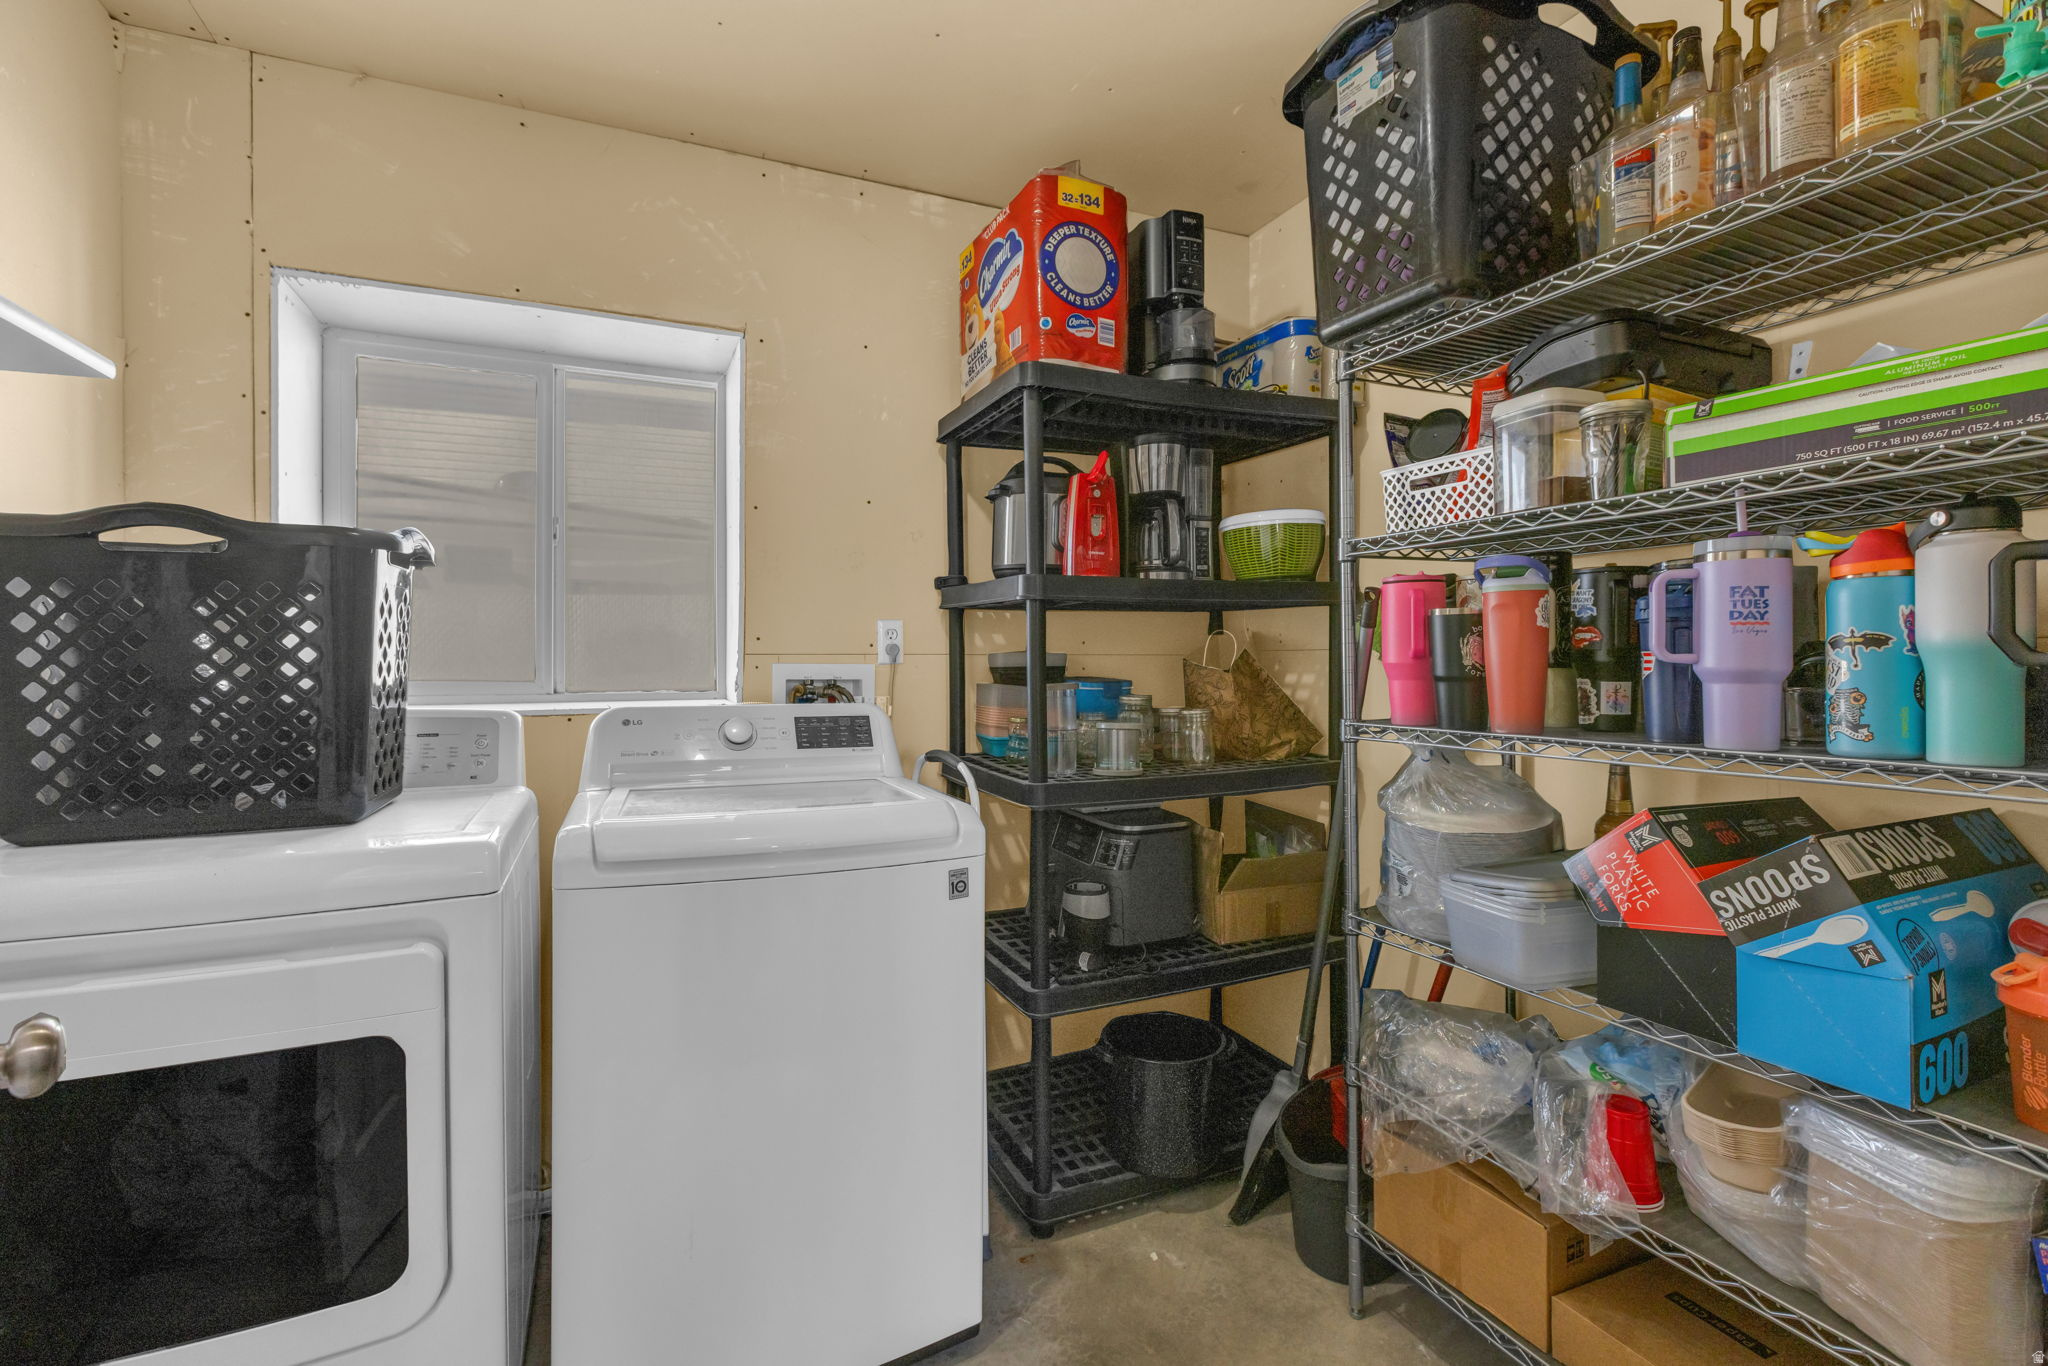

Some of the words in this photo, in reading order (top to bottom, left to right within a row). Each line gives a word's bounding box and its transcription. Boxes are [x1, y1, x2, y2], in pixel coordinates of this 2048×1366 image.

[1044, 224, 1077, 252] DEEPER
[979, 239, 1011, 302] Charmin
[1001, 263, 1021, 290] Strong
[1046, 272, 1082, 306] CLEANS
[1083, 283, 1114, 307] BETTER
[967, 338, 988, 365] CLEANS
[967, 351, 989, 378] BETTER
[1884, 360, 1941, 375] ALUMINUM
[1944, 353, 1968, 364] FOIL
[1229, 352, 1257, 389] Scott
[1953, 370, 1973, 379] AVOID
[1894, 415, 1919, 426] FOOD
[1920, 407, 1957, 421] SERVICE
[1795, 451, 1812, 461] 750
[1814, 449, 1828, 458] SQ
[1830, 446, 1842, 455] FT
[1843, 442, 1866, 454] (500
[1867, 440, 1881, 449] FT
[1890, 437, 1901, 445] 18
[1903, 434, 1919, 443] IN)
[1921, 428, 1949, 440] 69.67
[1967, 420, 2001, 434] (152.4
[2003, 418, 2014, 427] m
[1729, 585, 1770, 598] FAT
[1729, 599, 1770, 609] TUES
[1728, 610, 1769, 621] DAY
[1854, 822, 1956, 871] SPOONS
[1598, 864, 1632, 912] FORKS
[1606, 851, 1650, 912] PLASTIC
[1622, 849, 1661, 899] WHITE
[1709, 854, 1831, 918] SPOONS
[1888, 868, 1926, 890] PLASTIC
[1922, 864, 1949, 884] WHITE
[1586, 881, 1609, 913] COUNT
[1764, 897, 1801, 918] WHITE
[1724, 909, 1767, 932] PLASTIC
[1919, 1031, 1969, 1104] 600
[2020, 1033, 2033, 1084] Blender
[2033, 1051, 2048, 1088] Bottle
